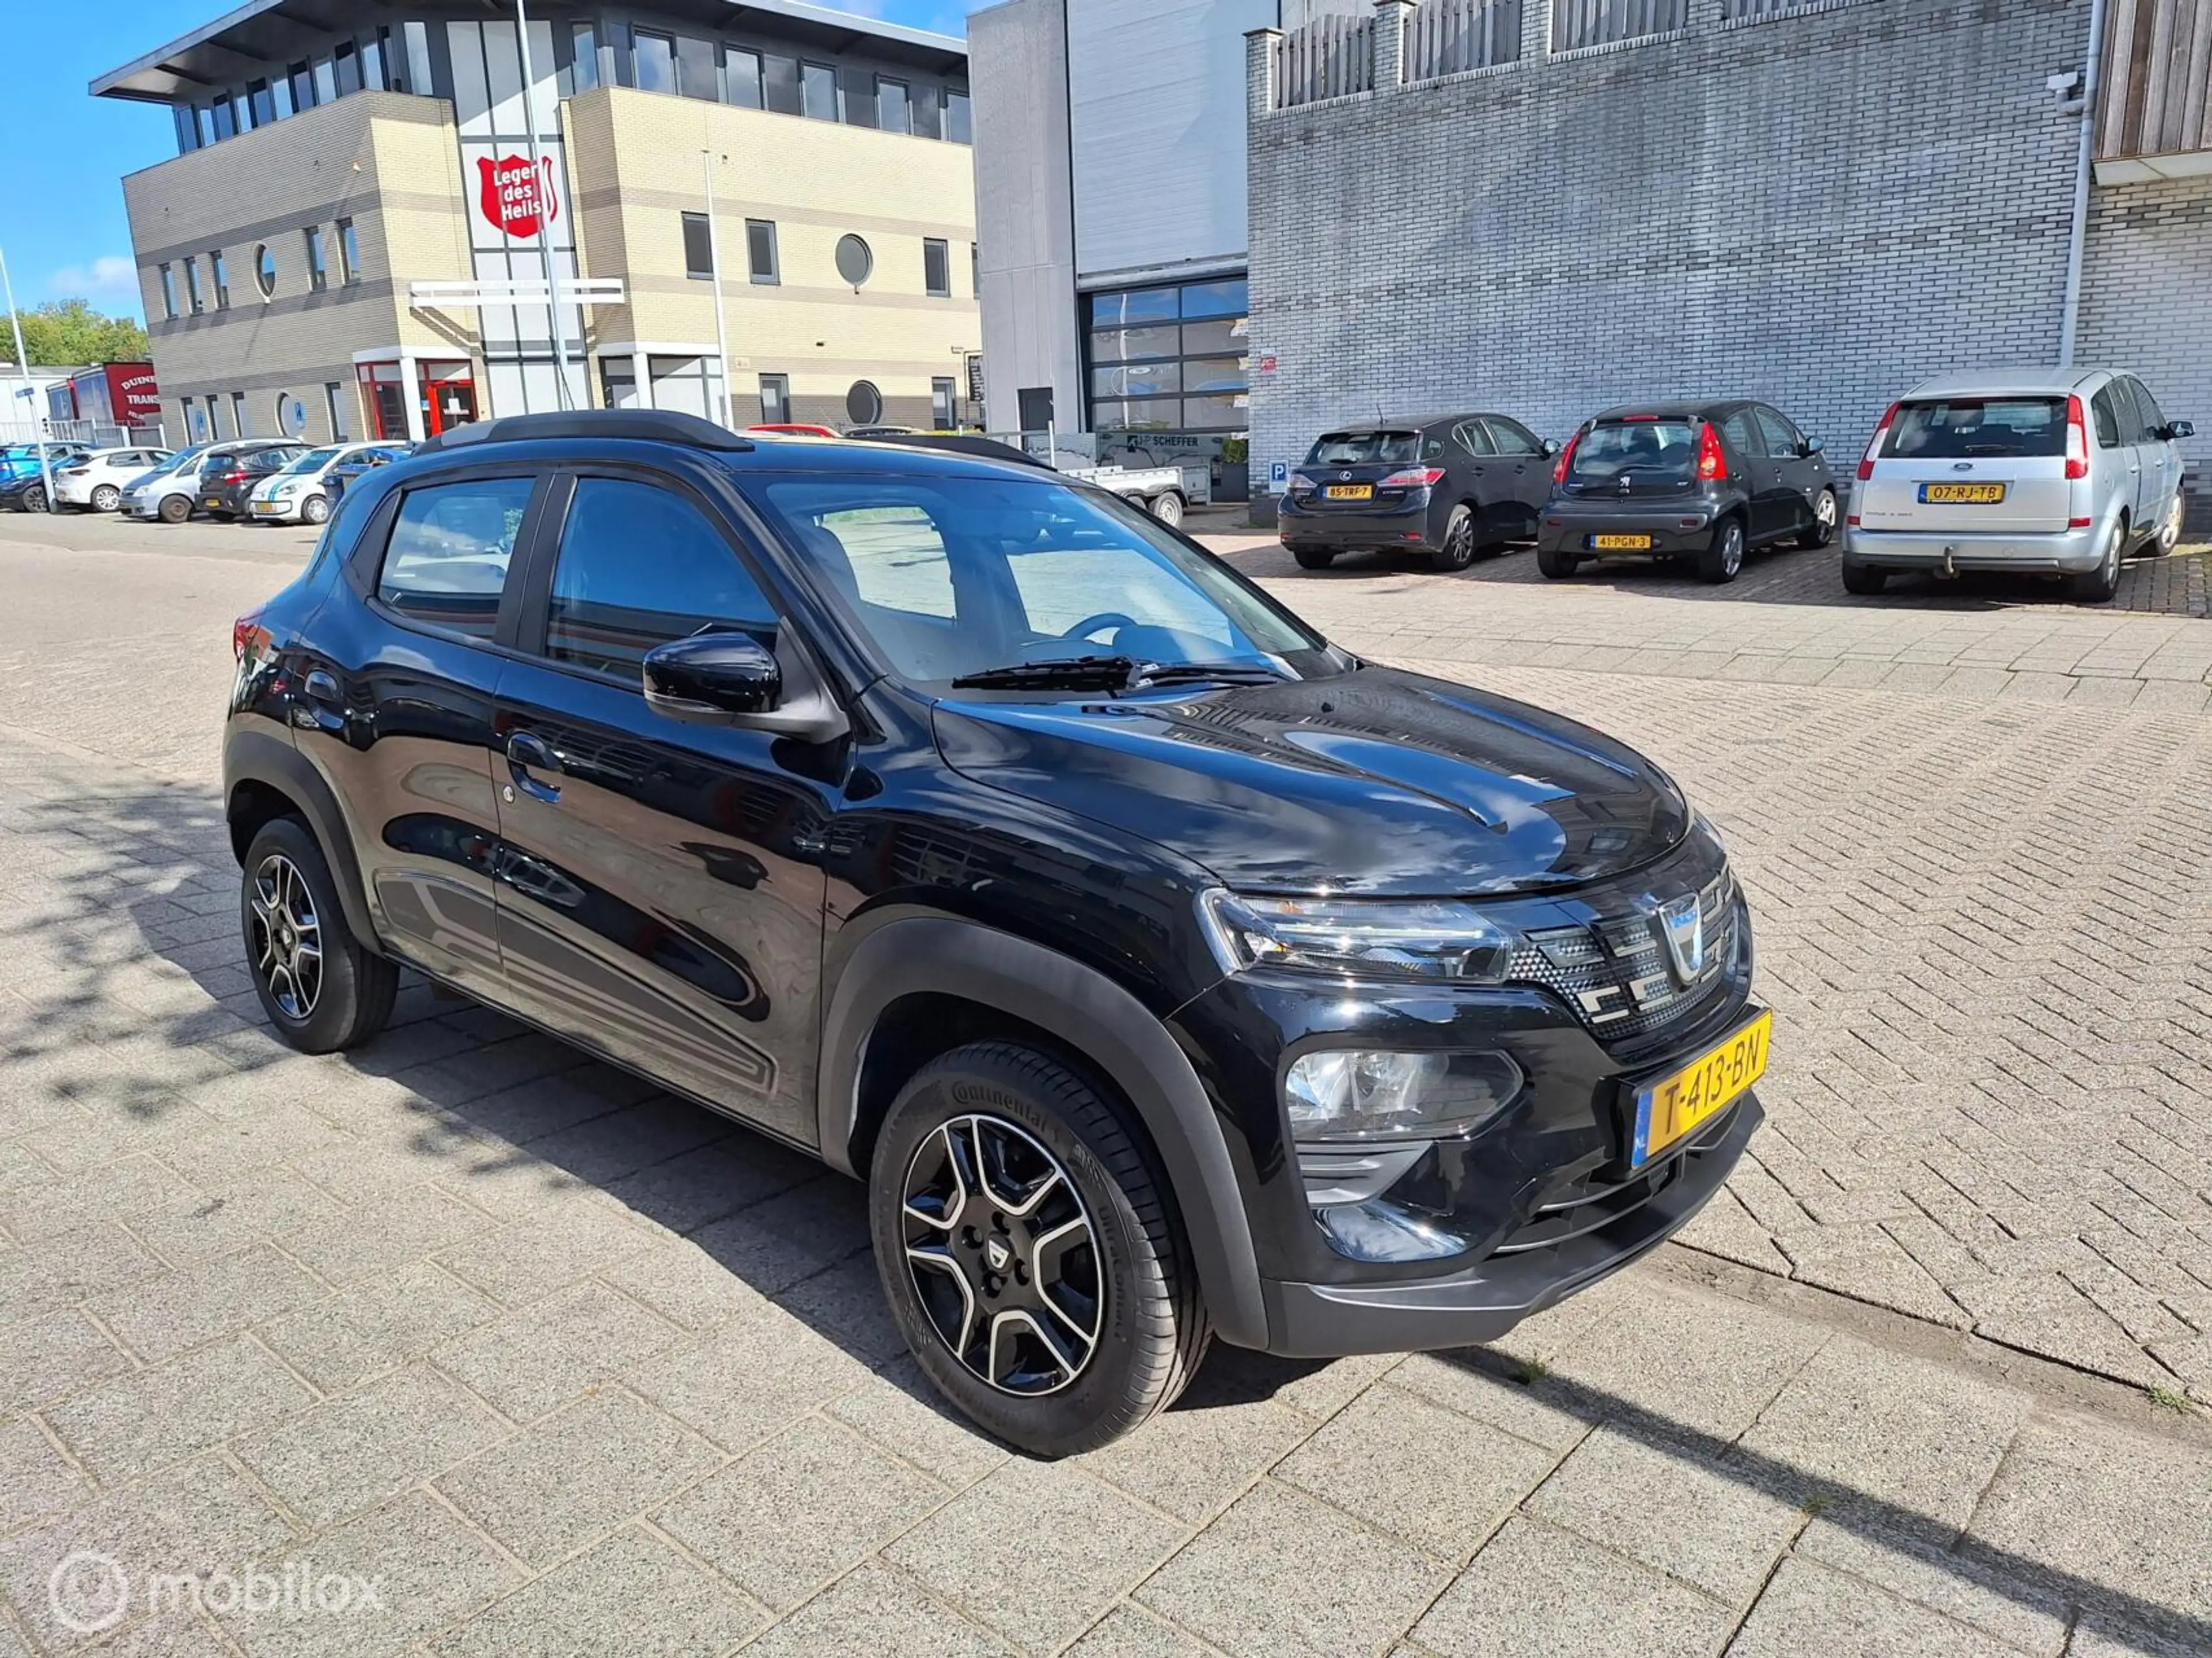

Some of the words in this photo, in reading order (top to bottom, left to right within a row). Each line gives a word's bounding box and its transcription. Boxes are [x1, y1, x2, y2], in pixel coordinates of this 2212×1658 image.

[493, 164, 537, 186] Leger
[504, 185, 532, 202] des
[501, 199, 541, 221] Heils
[1153, 436, 1198, 446] SCHEFFER
[1275, 464, 1284, 479] P
[1329, 486, 1368, 496] 85-TRF-7
[1933, 486, 1997, 499] 07-RJ-TB
[1599, 536, 1646, 546] 41-PGN-3
[1665, 1029, 1760, 1135] T-413-BN
[952, 1080, 1048, 1133] Continental
